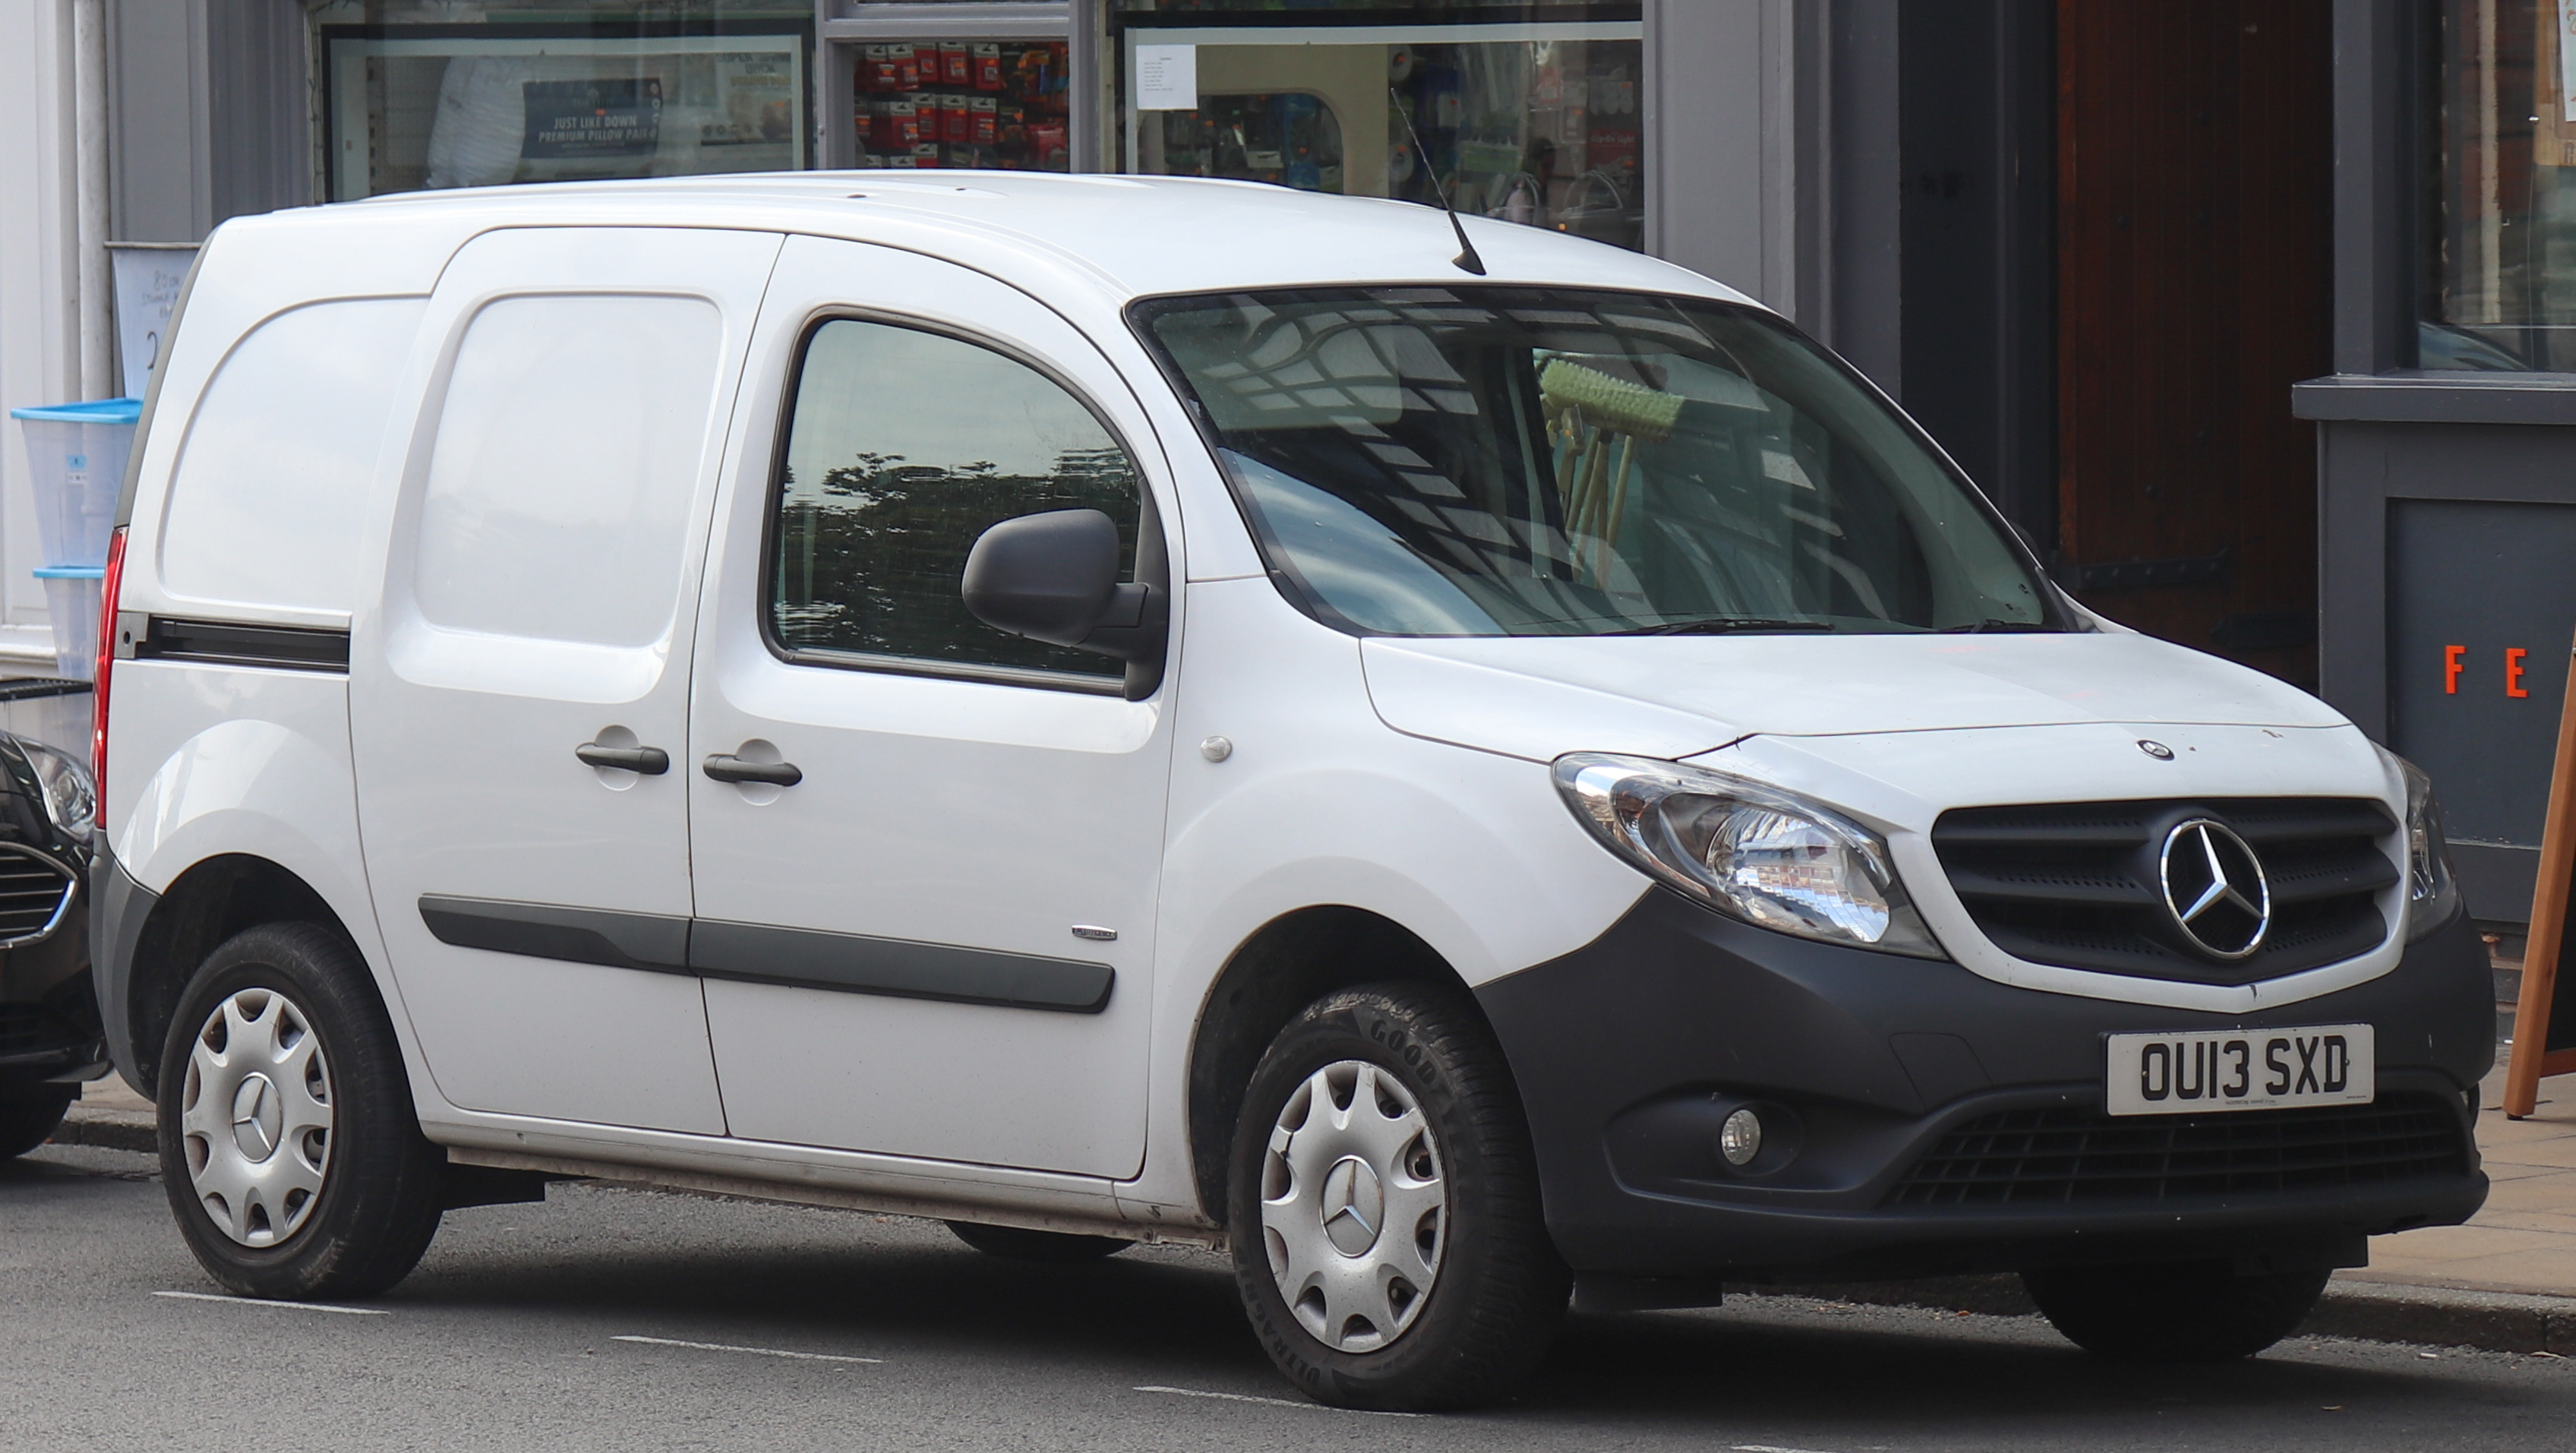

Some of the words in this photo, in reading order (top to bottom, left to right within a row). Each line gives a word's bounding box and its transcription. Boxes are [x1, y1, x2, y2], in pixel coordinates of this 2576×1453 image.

[554, 116, 576, 129] JUST
[580, 115, 601, 128] LIKE
[605, 115, 636, 128] DOWN
[538, 130, 585, 143] PREMIUM
[589, 129, 623, 141] PILLOW
[2141, 1040, 2249, 1101] OU13
[2265, 1034, 2347, 1096] SXD
